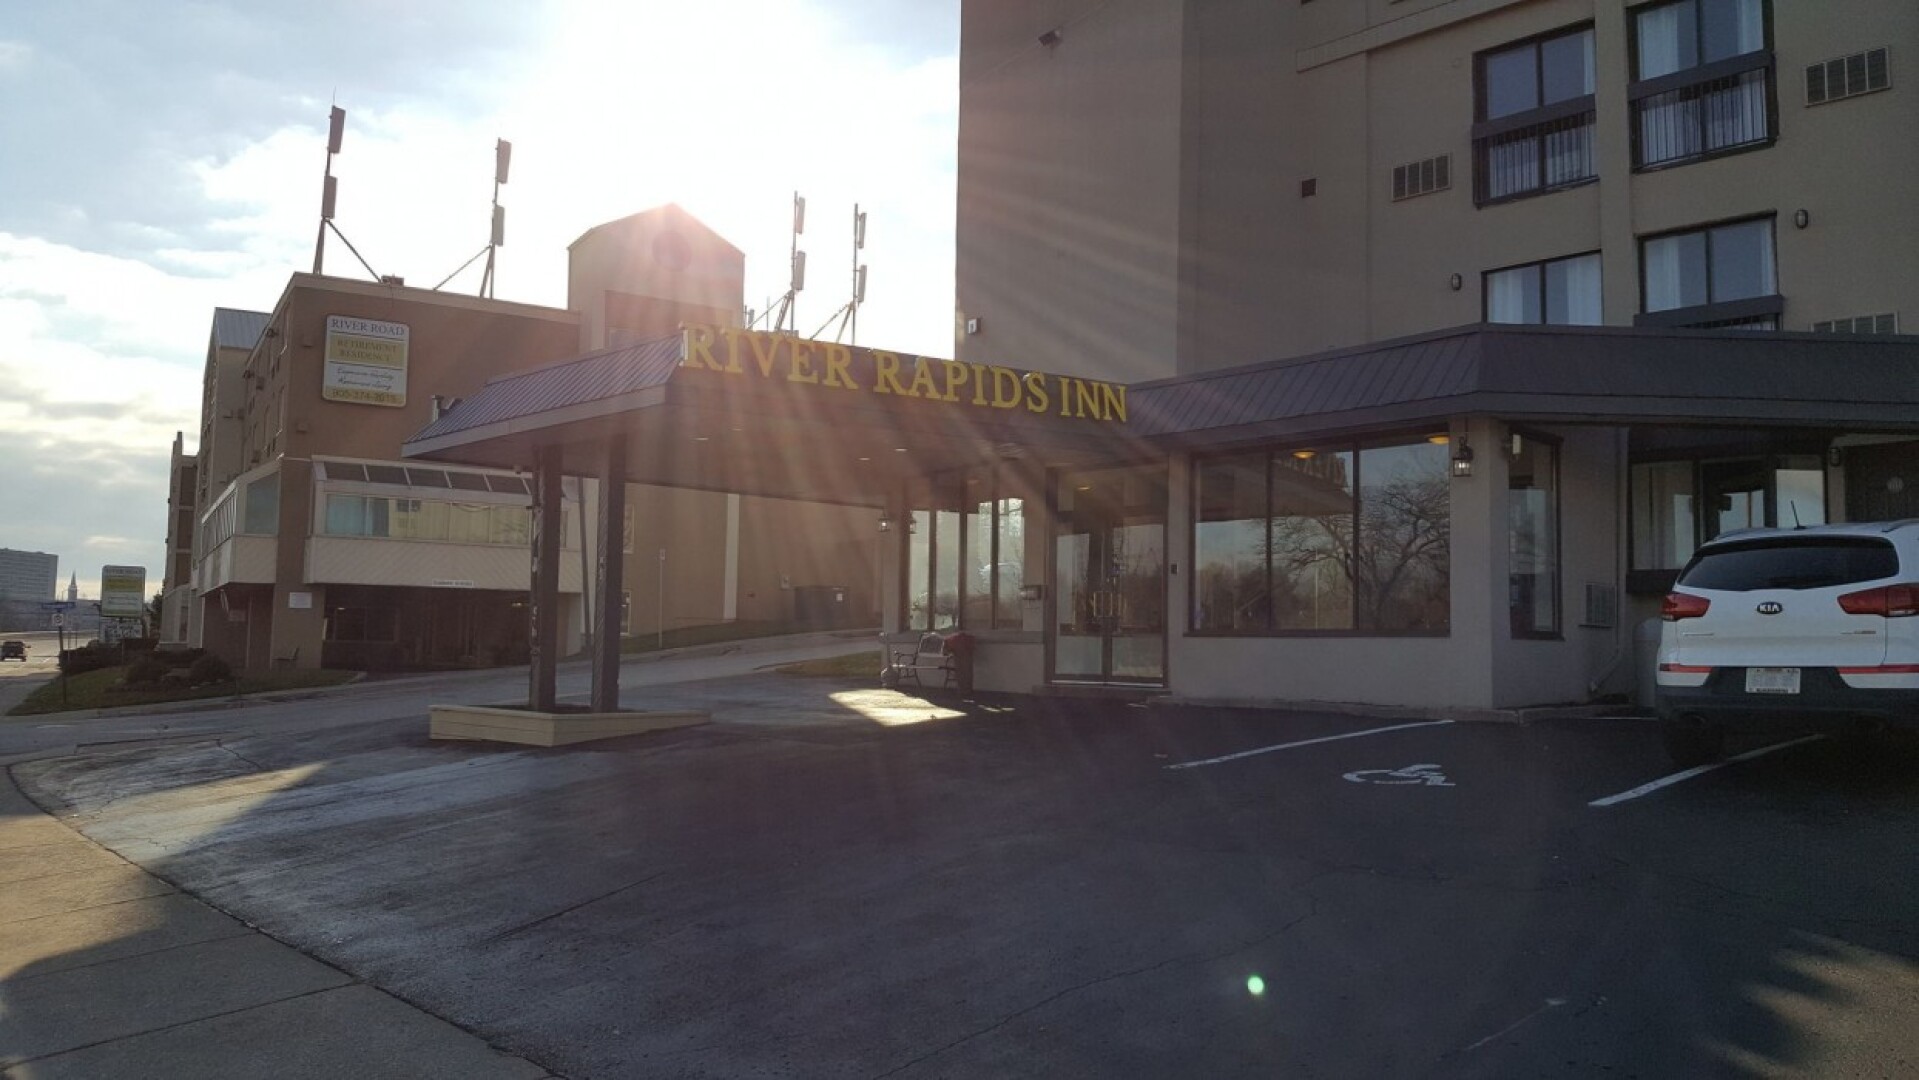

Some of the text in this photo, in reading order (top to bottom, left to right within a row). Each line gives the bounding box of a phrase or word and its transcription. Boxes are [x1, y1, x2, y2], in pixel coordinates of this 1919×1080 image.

[332, 319, 404, 336] RIVER ROAD
[337, 340, 397, 353] RETIREMENT
[679, 321, 1128, 423] RIVER RAPIDS INN
[1759, 604, 1780, 613] KIA
